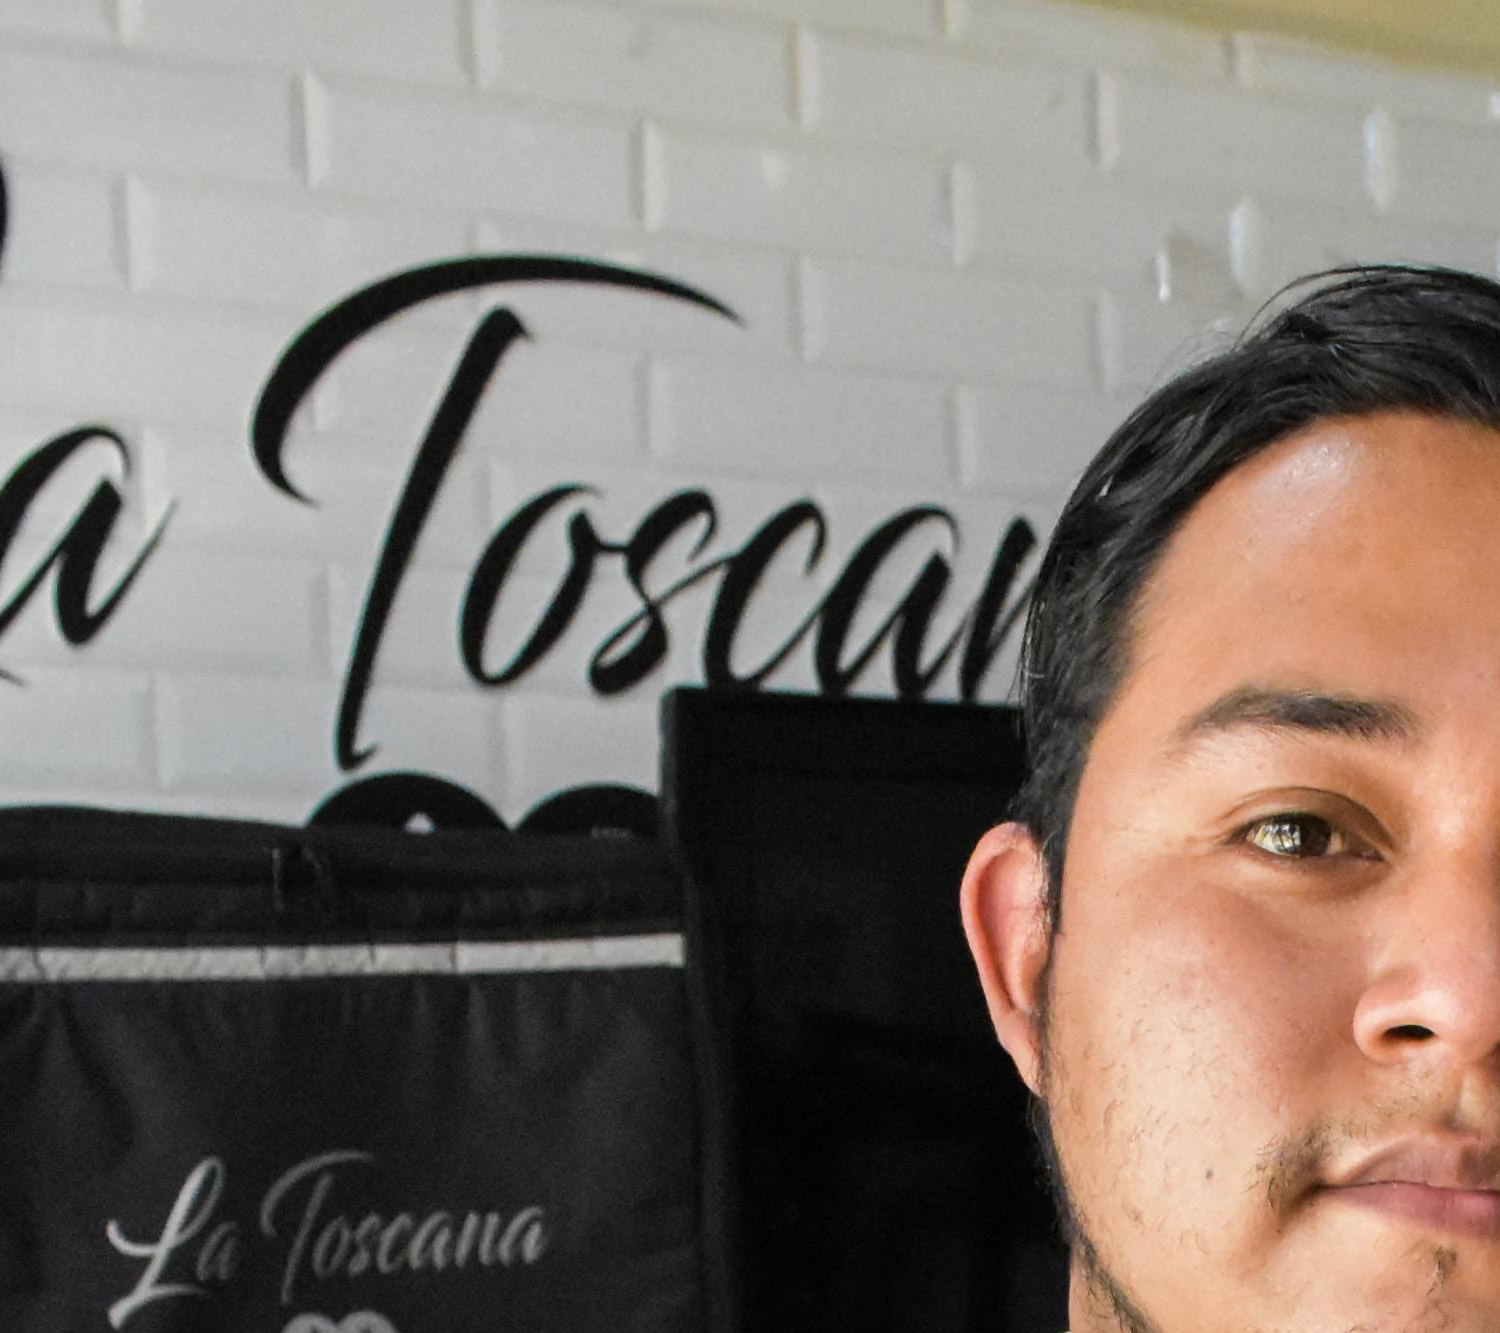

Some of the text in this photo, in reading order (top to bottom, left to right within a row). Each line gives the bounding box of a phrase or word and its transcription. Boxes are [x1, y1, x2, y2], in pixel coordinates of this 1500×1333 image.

[252, 253, 1042, 772] Toscan
[104, 1149, 551, 1332] La Toscana
